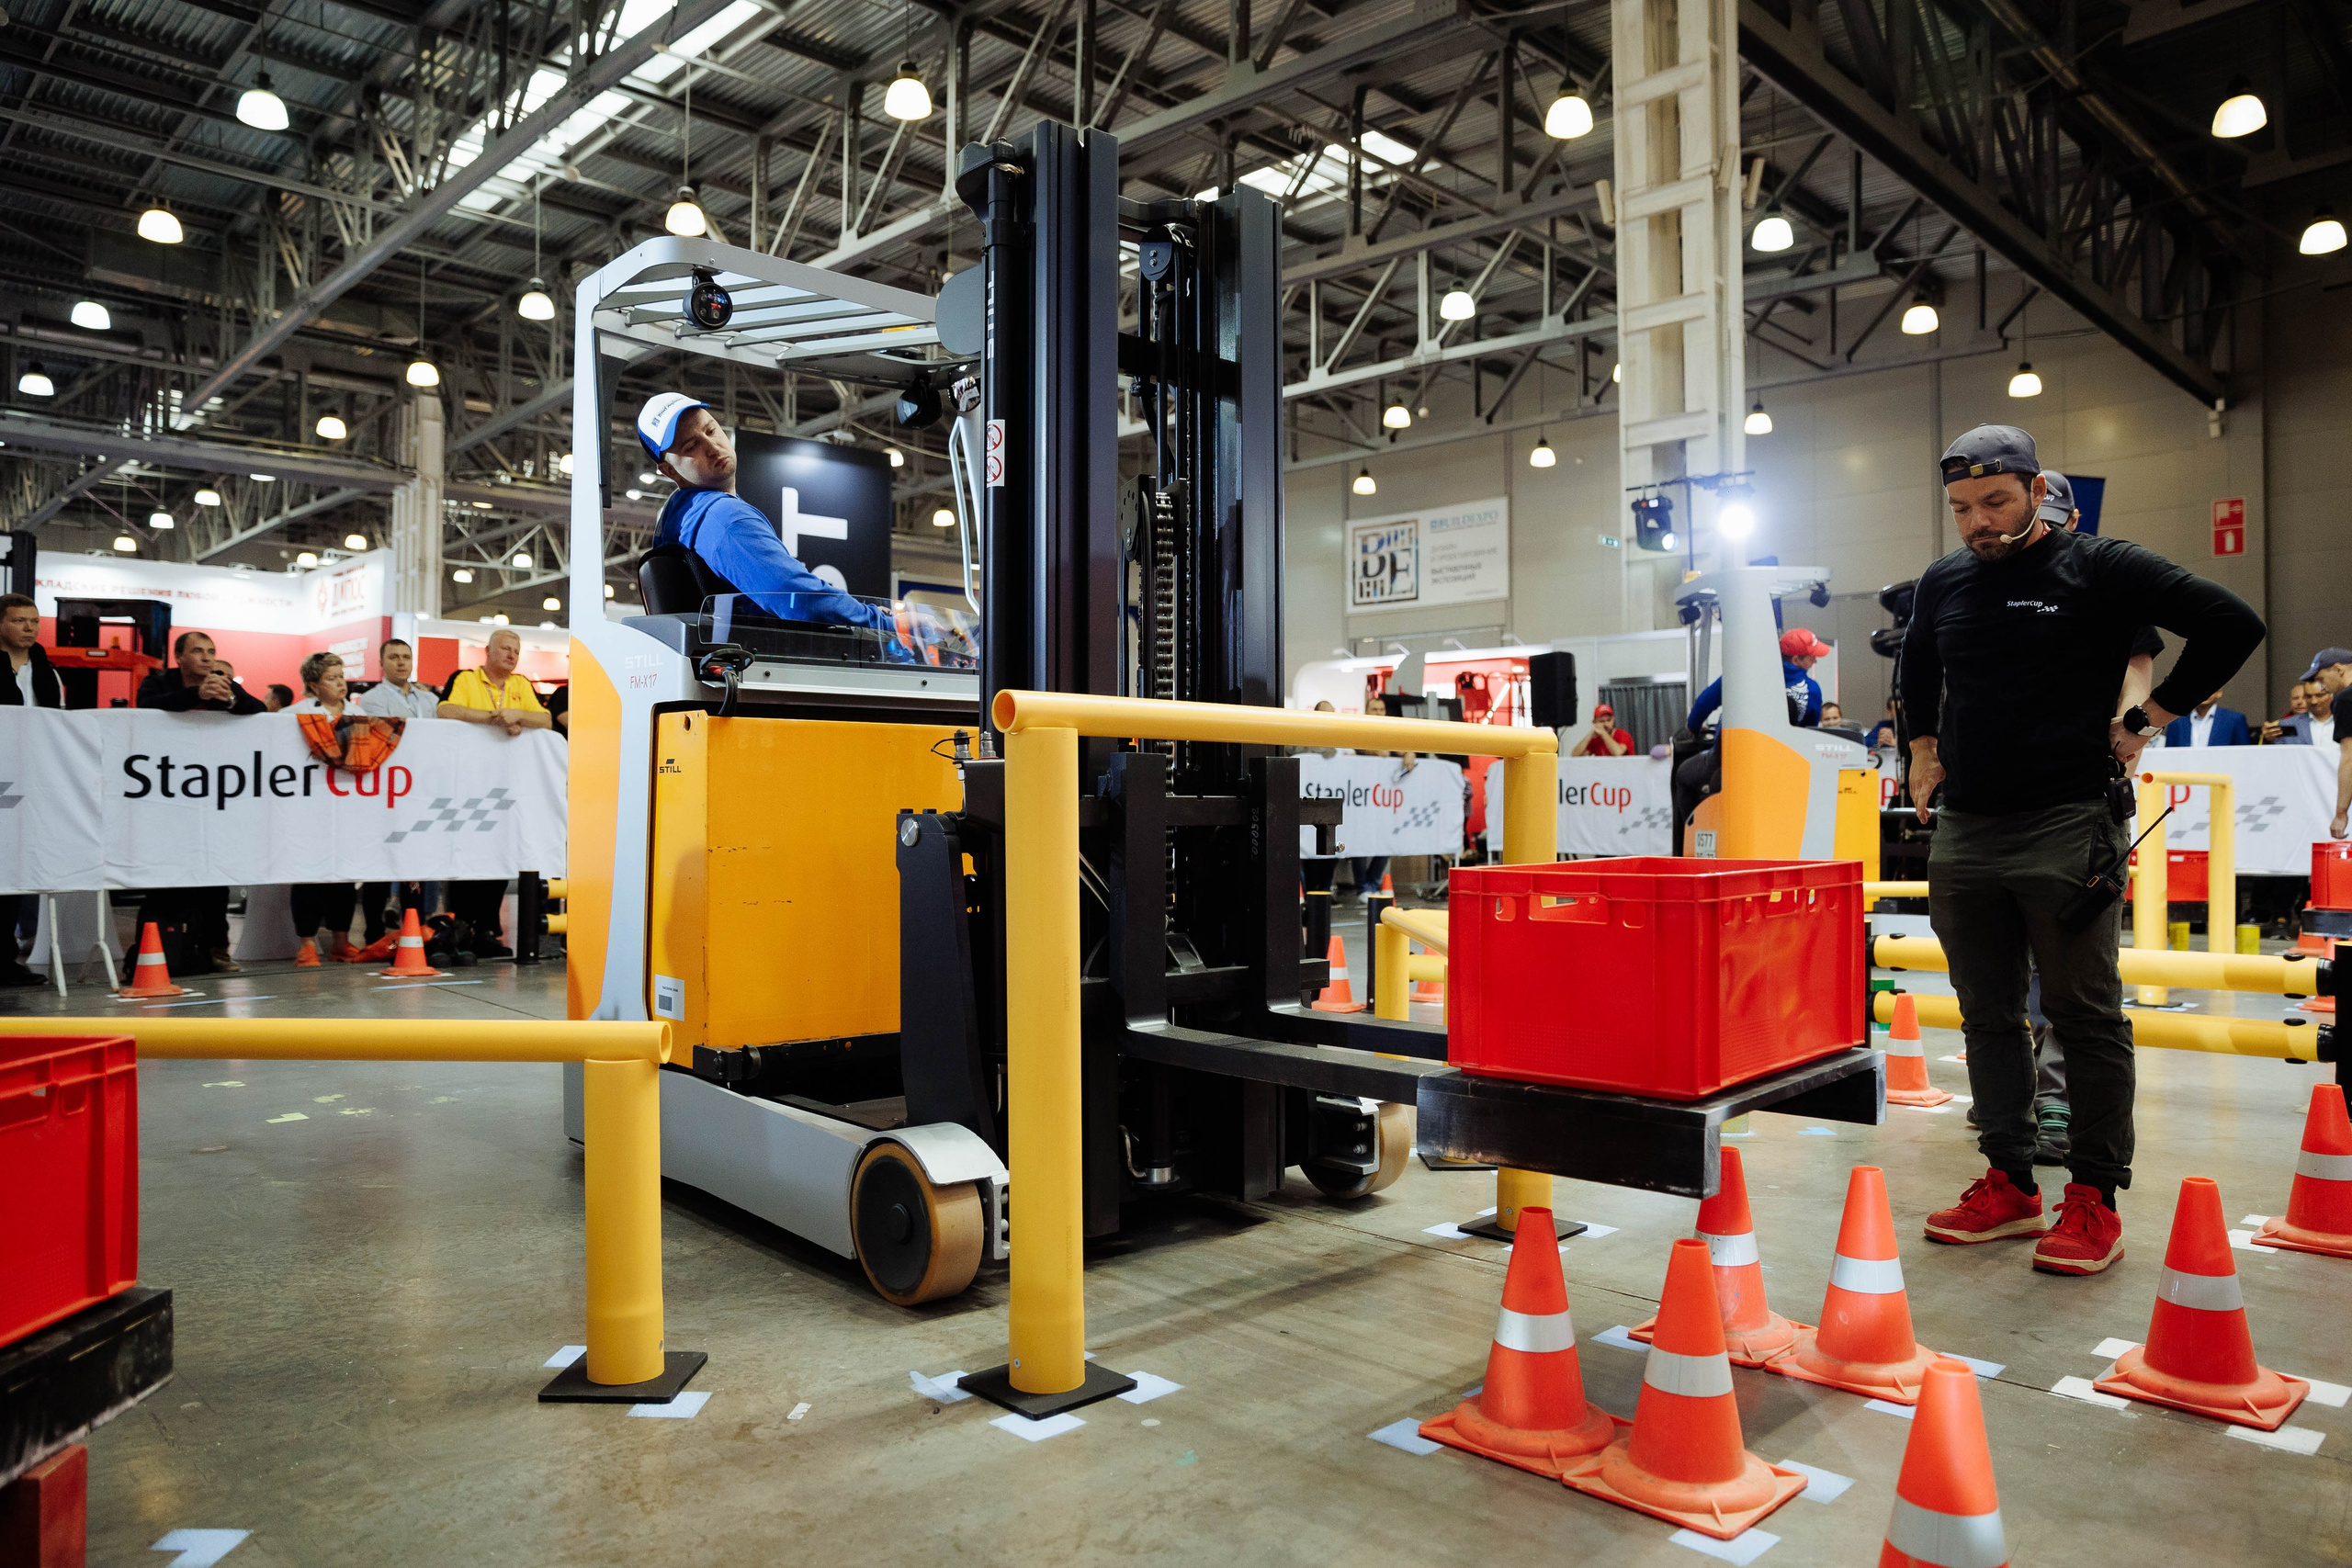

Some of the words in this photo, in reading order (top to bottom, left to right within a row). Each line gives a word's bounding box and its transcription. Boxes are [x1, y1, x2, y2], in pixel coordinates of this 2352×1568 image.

[35, 578, 107, 592] КЛАДСКИЕ
[2007, 600, 2043, 608] StaplerCup
[625, 653, 664, 670] STILL
[630, 673, 658, 689] FM-X17
[1815, 743, 1854, 752] STILL
[659, 765, 682, 773] STILL
[123, 750, 413, 810] StaplerCup
